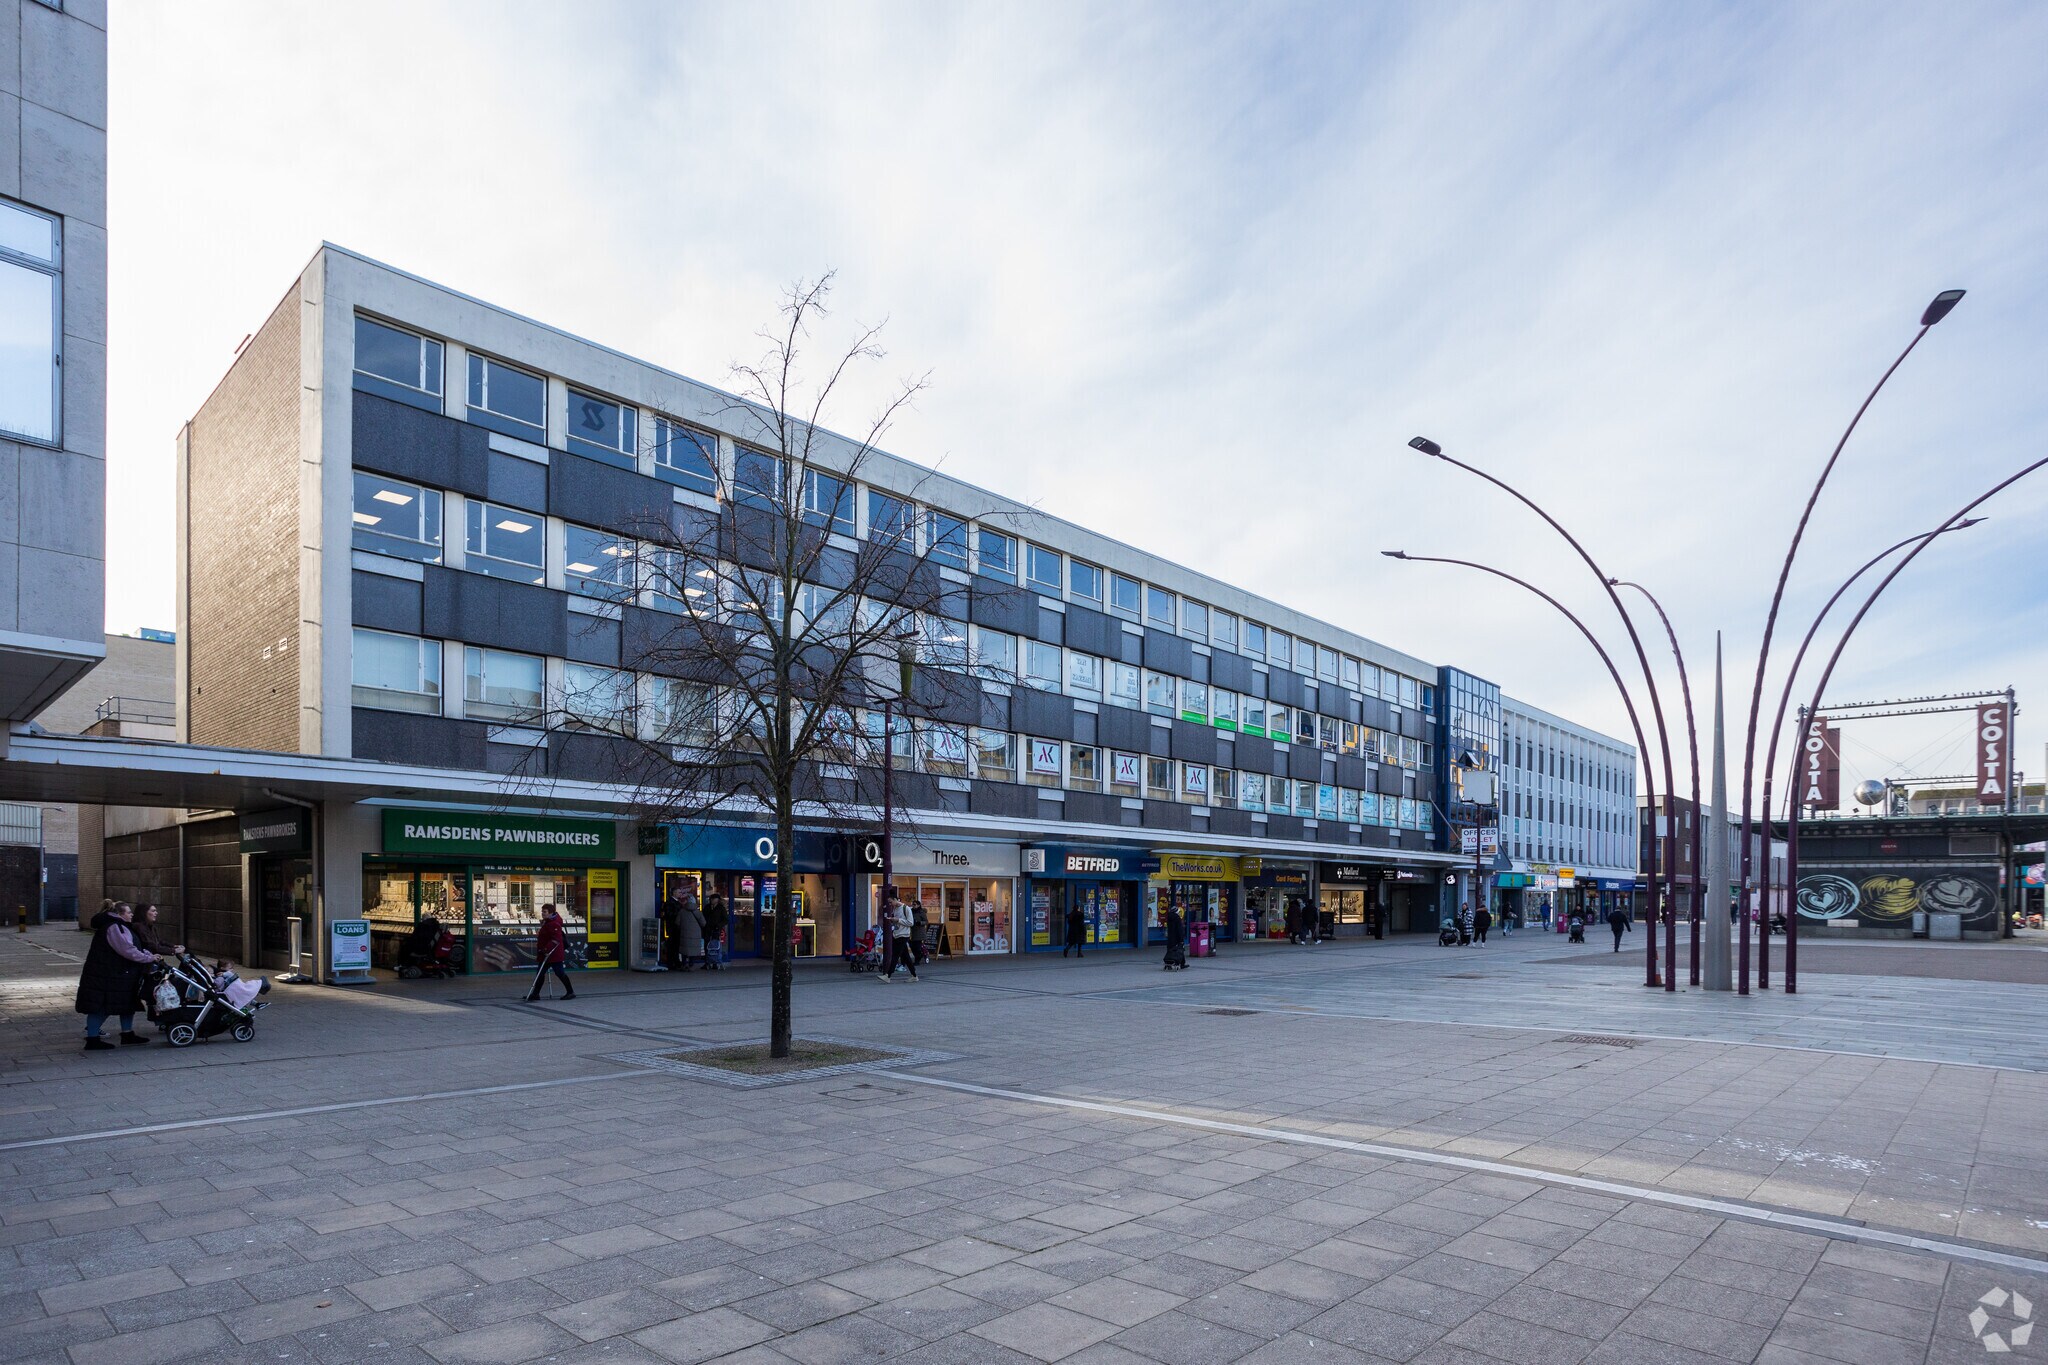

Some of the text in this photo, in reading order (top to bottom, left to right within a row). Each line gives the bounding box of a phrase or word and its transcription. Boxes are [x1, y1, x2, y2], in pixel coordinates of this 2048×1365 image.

[1980, 708, 2004, 795] COSTA
[1805, 721, 1823, 801] COSTA
[404, 824, 600, 846] RAMSDENS PAWNBROKERS
[755, 837, 778, 865] O2
[865, 841, 884, 868] O2
[932, 850, 970, 866] Three.
[1067, 856, 1119, 872] BETFRED
[1172, 862, 1222, 873] TheWorks.co.uk
[1287, 876, 1302, 884] Factory
[974, 901, 994, 913] Sale
[972, 933, 1009, 951] Sale
